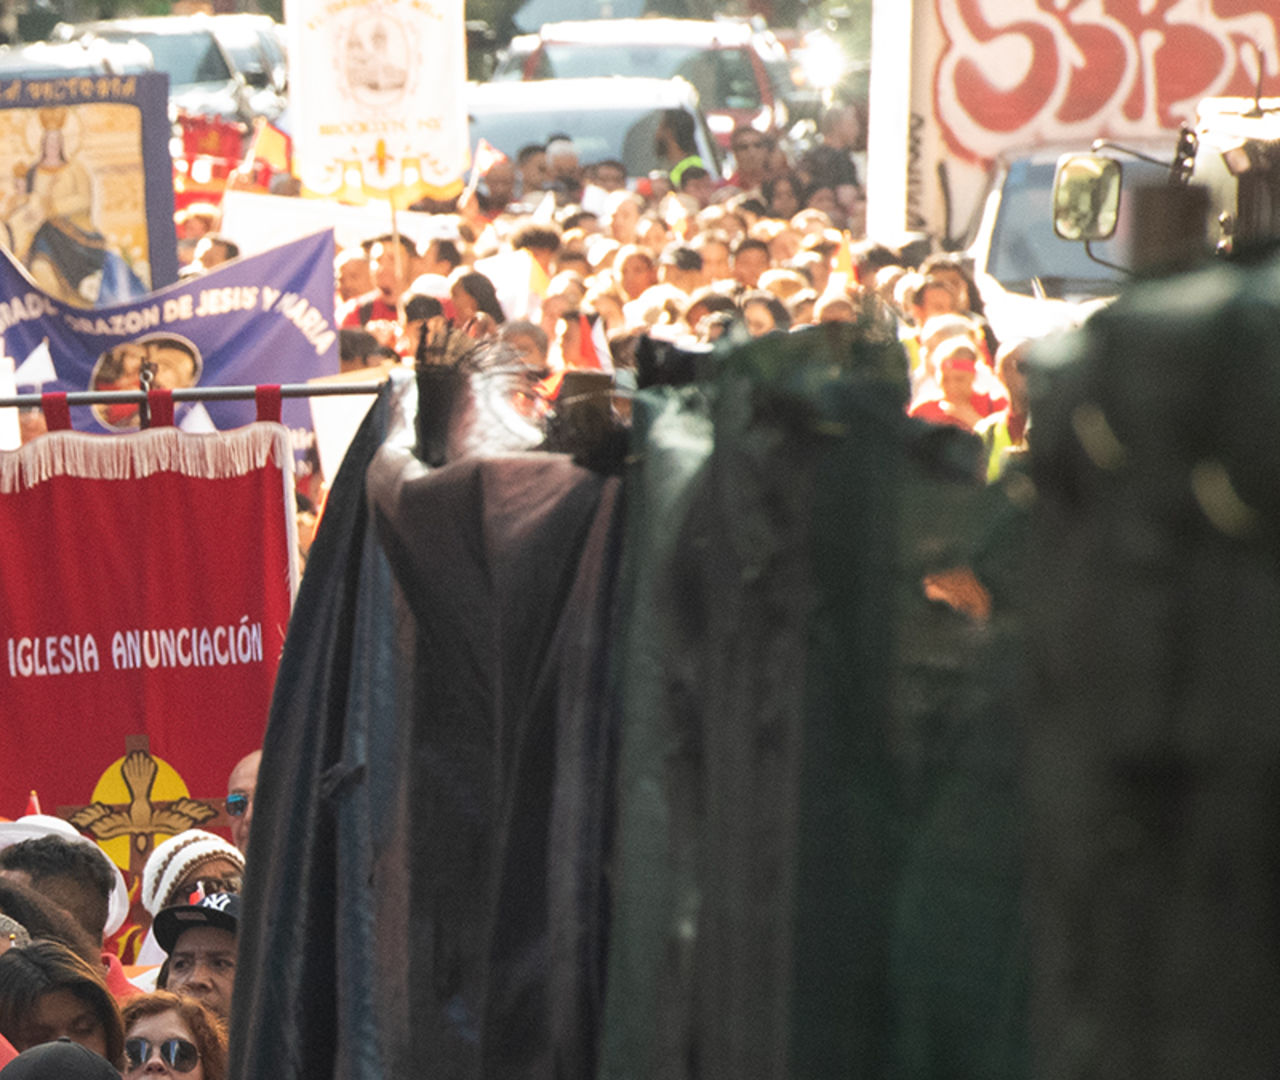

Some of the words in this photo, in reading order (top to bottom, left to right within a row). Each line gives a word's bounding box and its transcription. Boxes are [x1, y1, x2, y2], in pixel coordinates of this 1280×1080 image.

[162, 295, 193, 322] DE
[261, 285, 280, 312] Y
[8, 633, 101, 677] IGLESIA
[111, 614, 263, 670] ANUNCIACIÓN
